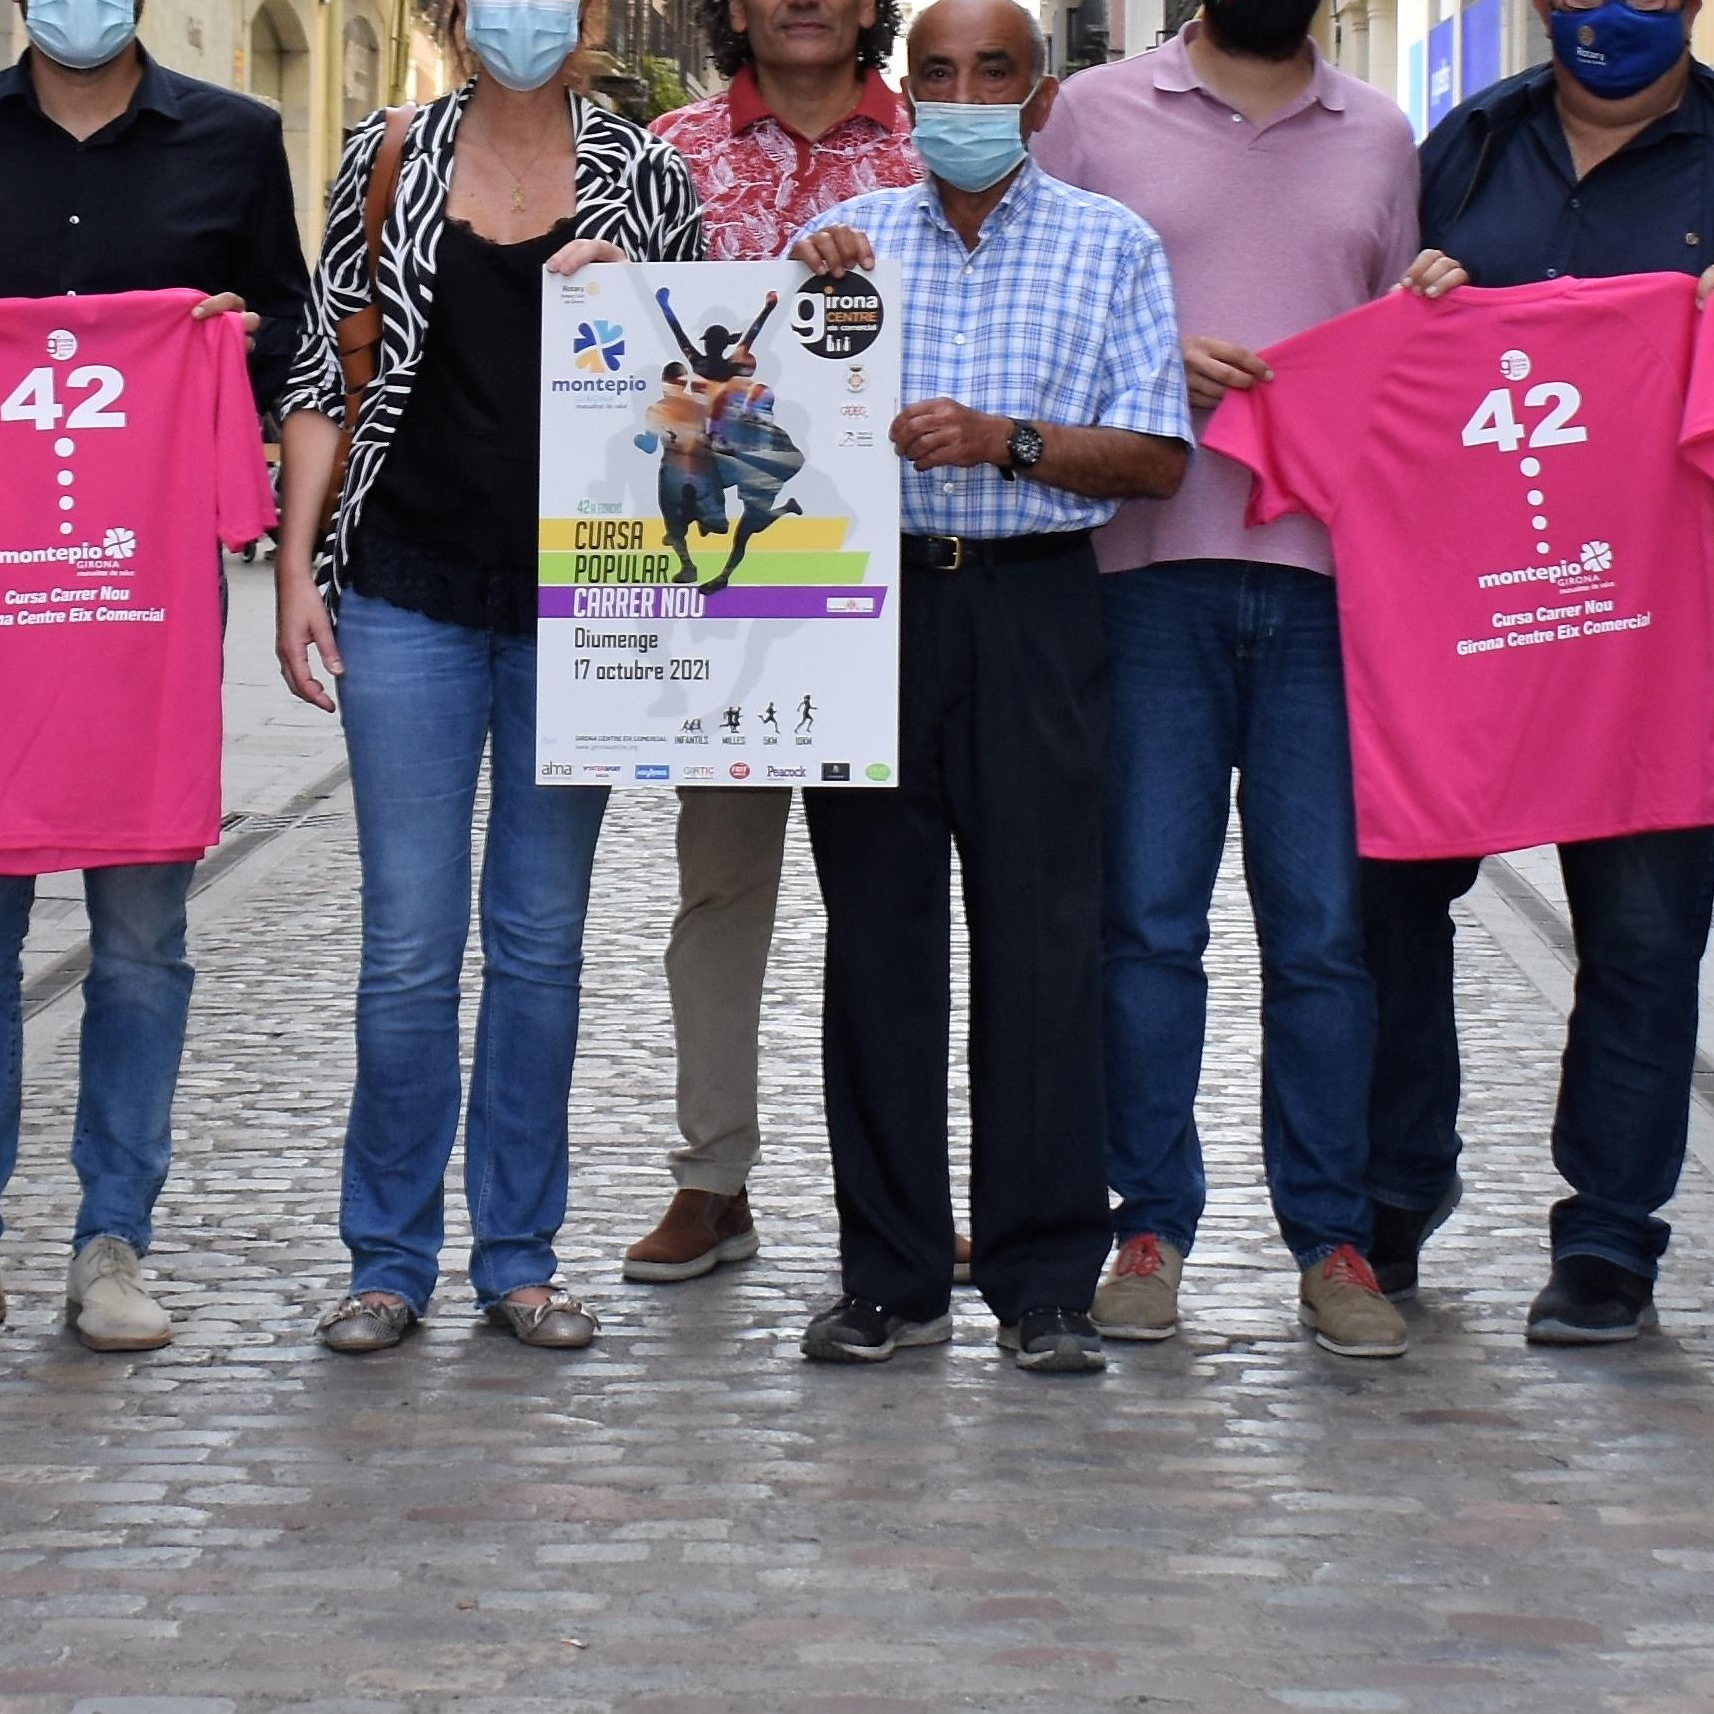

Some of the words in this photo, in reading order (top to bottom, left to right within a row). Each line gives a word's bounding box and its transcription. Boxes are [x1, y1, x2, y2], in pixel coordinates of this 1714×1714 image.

[826, 311, 878, 323] CENTRE
[552, 375, 647, 396] montepio
[0, 365, 126, 431] 42
[1461, 381, 1588, 452] 42
[575, 521, 644, 550] CURSA
[76, 560, 120, 569] GIRONA
[574, 554, 670, 583] POPULAR
[1478, 559, 1581, 589] montepio
[1557, 575, 1600, 587] GIRONA
[4, 589, 47, 606] Cursa
[50, 587, 98, 604] Carrer
[99, 585, 130, 601] Nou
[573, 587, 655, 618] CARRER
[660, 587, 705, 618] NOU
[16, 609, 66, 626] Centre
[68, 608, 93, 623] Eix
[95, 606, 165, 623] Comercial
[1492, 611, 1534, 629] Cursa
[1536, 604, 1581, 623] Carrer
[1585, 597, 1614, 614] Nou
[574, 627, 659, 654] Diumenge
[1456, 637, 1504, 656] Girona
[1506, 629, 1554, 648] Centre
[1557, 622, 1580, 641] Eix
[1583, 611, 1651, 636] Comercial
[574, 659, 591, 680] 17
[596, 659, 664, 680] octubre
[670, 659, 710, 680] 2021
[674, 736, 709, 745] INFANTILS
[541, 761, 572, 776] alma
[767, 765, 807, 779] Peacock
